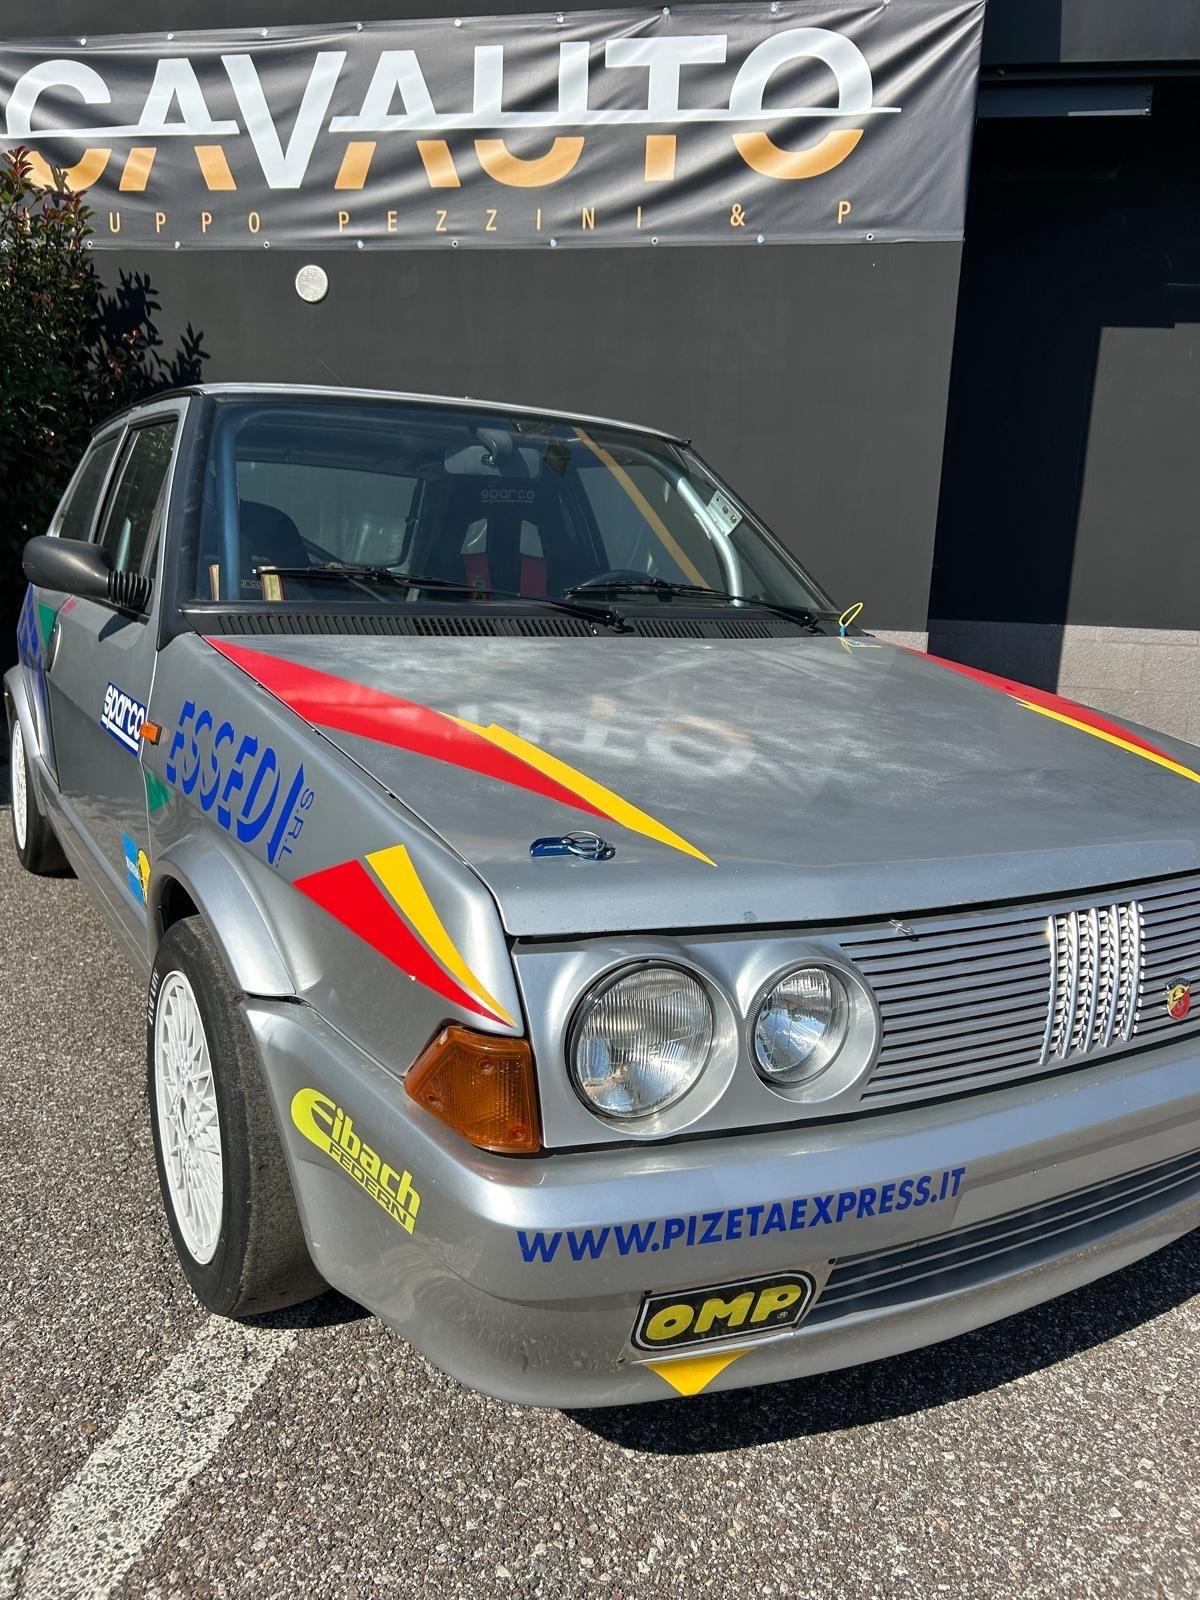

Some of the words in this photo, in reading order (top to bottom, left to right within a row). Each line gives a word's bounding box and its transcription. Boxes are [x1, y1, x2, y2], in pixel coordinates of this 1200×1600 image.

[4, 27, 880, 192] CAVAUTO
[108, 211, 260, 233] UPPO
[338, 206, 642, 232] PEZZINI
[729, 204, 746, 226] &
[838, 201, 851, 225] P
[480, 488, 536, 504] sparco
[102, 684, 145, 743] sparco
[290, 1087, 421, 1219] Eibach
[329, 1141, 411, 1227] FEDERN
[516, 1166, 967, 1263] WWW.PIZETAEXPRESS.IT
[645, 1284, 802, 1341] OMP
